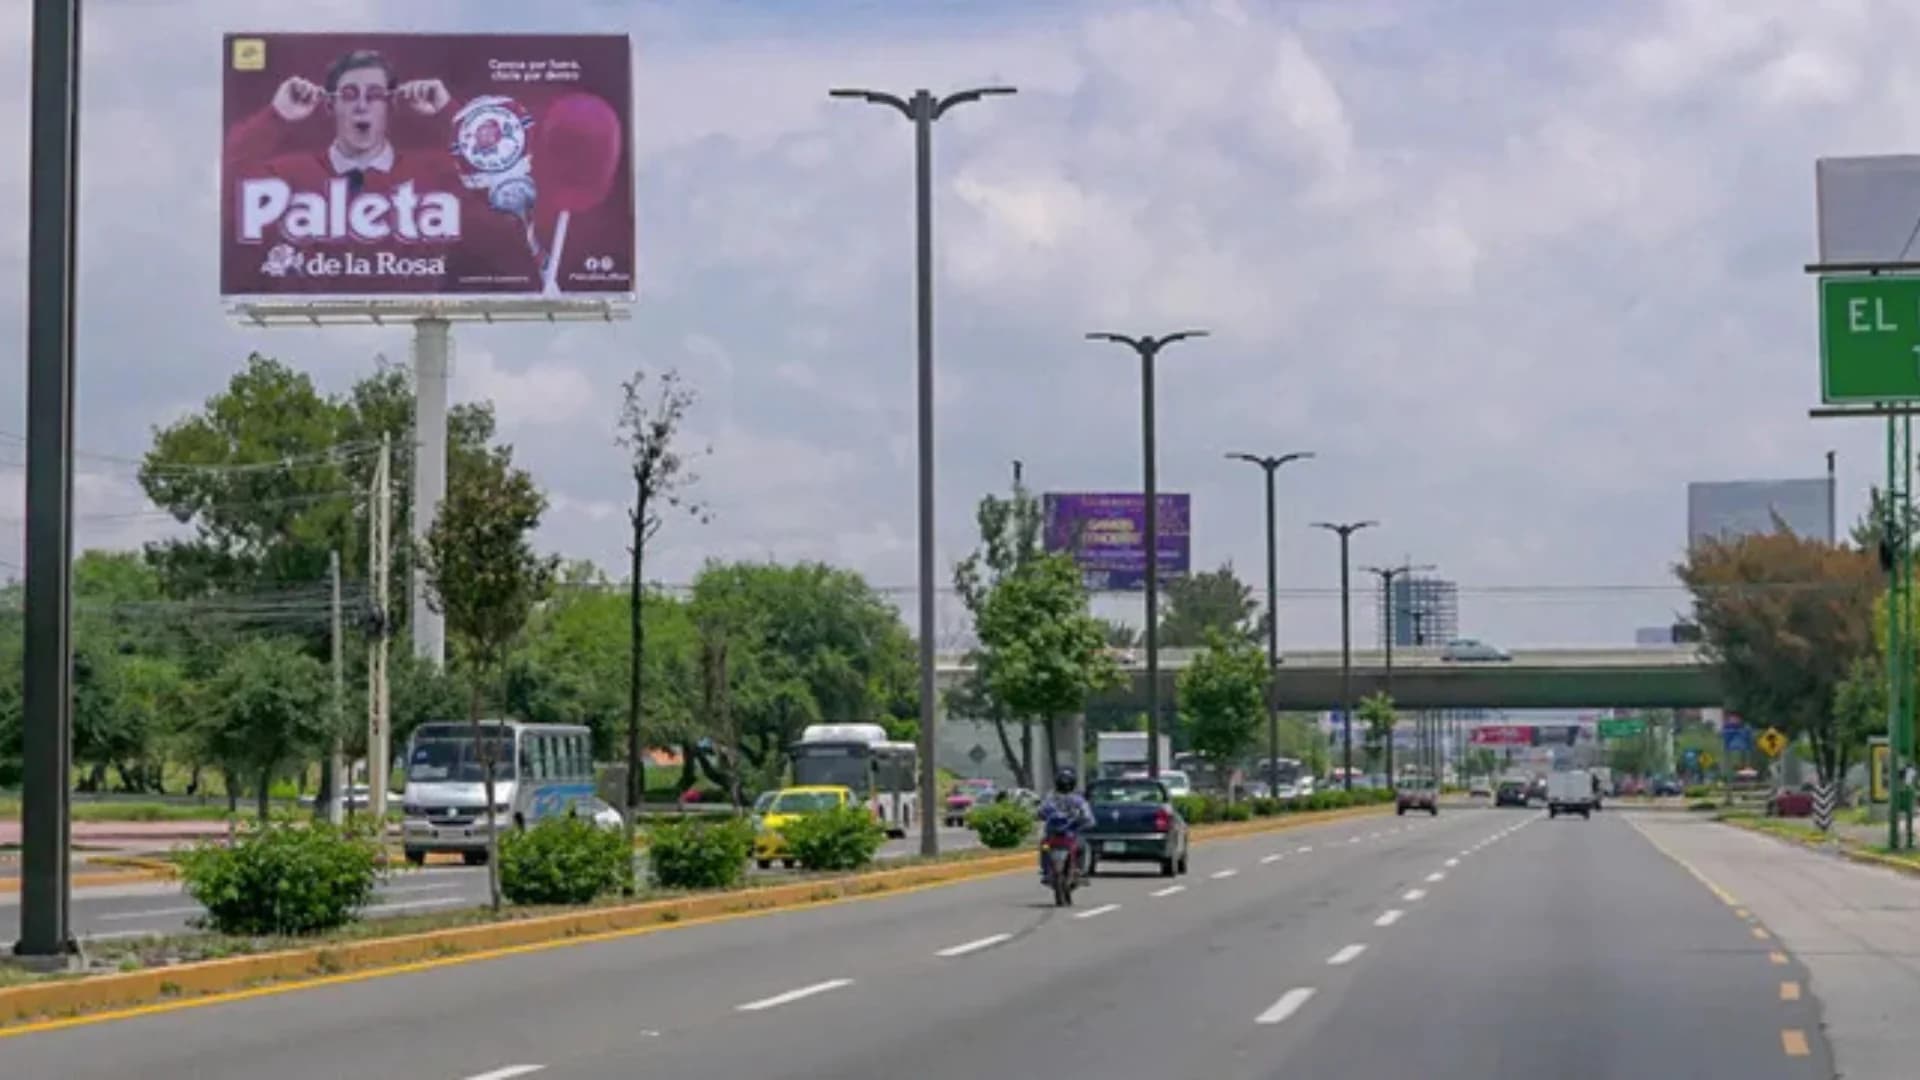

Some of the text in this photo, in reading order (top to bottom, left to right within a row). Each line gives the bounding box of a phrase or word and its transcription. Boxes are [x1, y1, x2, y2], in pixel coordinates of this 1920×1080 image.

[241, 178, 461, 241] Paleta
[306, 250, 446, 276] de la Rosa
[1848, 298, 1898, 332] EL
